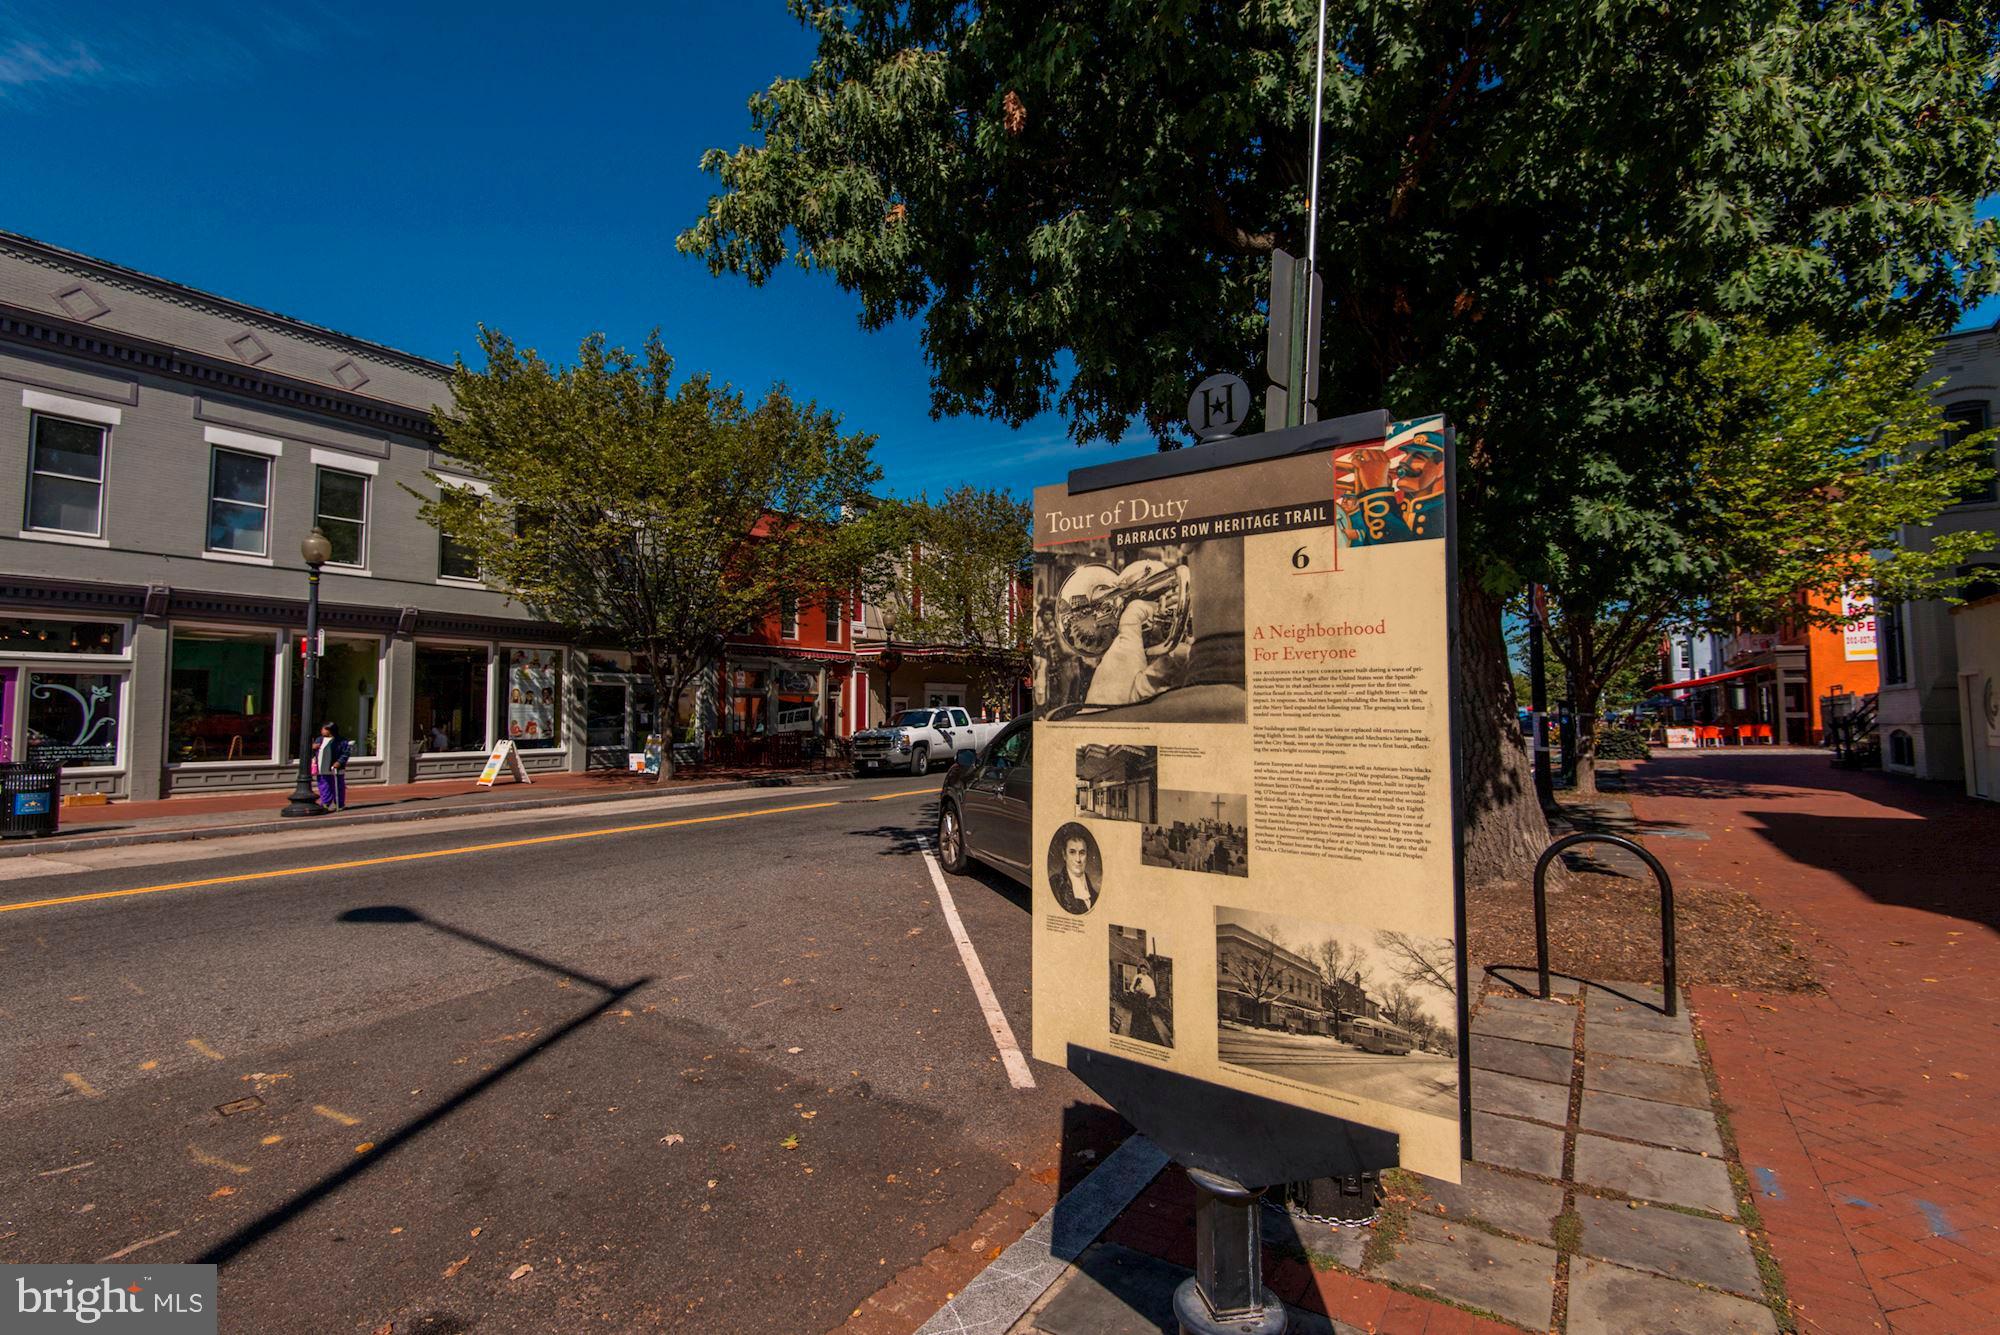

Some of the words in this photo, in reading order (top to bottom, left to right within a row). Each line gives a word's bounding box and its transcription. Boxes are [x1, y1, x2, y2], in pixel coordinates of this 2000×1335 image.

[1045, 511, 1095, 534] Tour
[1100, 500, 1125, 526] of
[1129, 498, 1189, 523] Duty
[1117, 526, 1177, 546] BARRACKS
[1181, 522, 1210, 538] ROW
[1214, 512, 1280, 534] HERITAGE
[1285, 507, 1327, 525] TRAIL
[1292, 545, 1310, 569] 6
[1253, 626, 1265, 640] A
[1269, 619, 1386, 643] Neighborhood
[1253, 647, 1279, 661] For
[1283, 646, 1357, 664] Everyone
